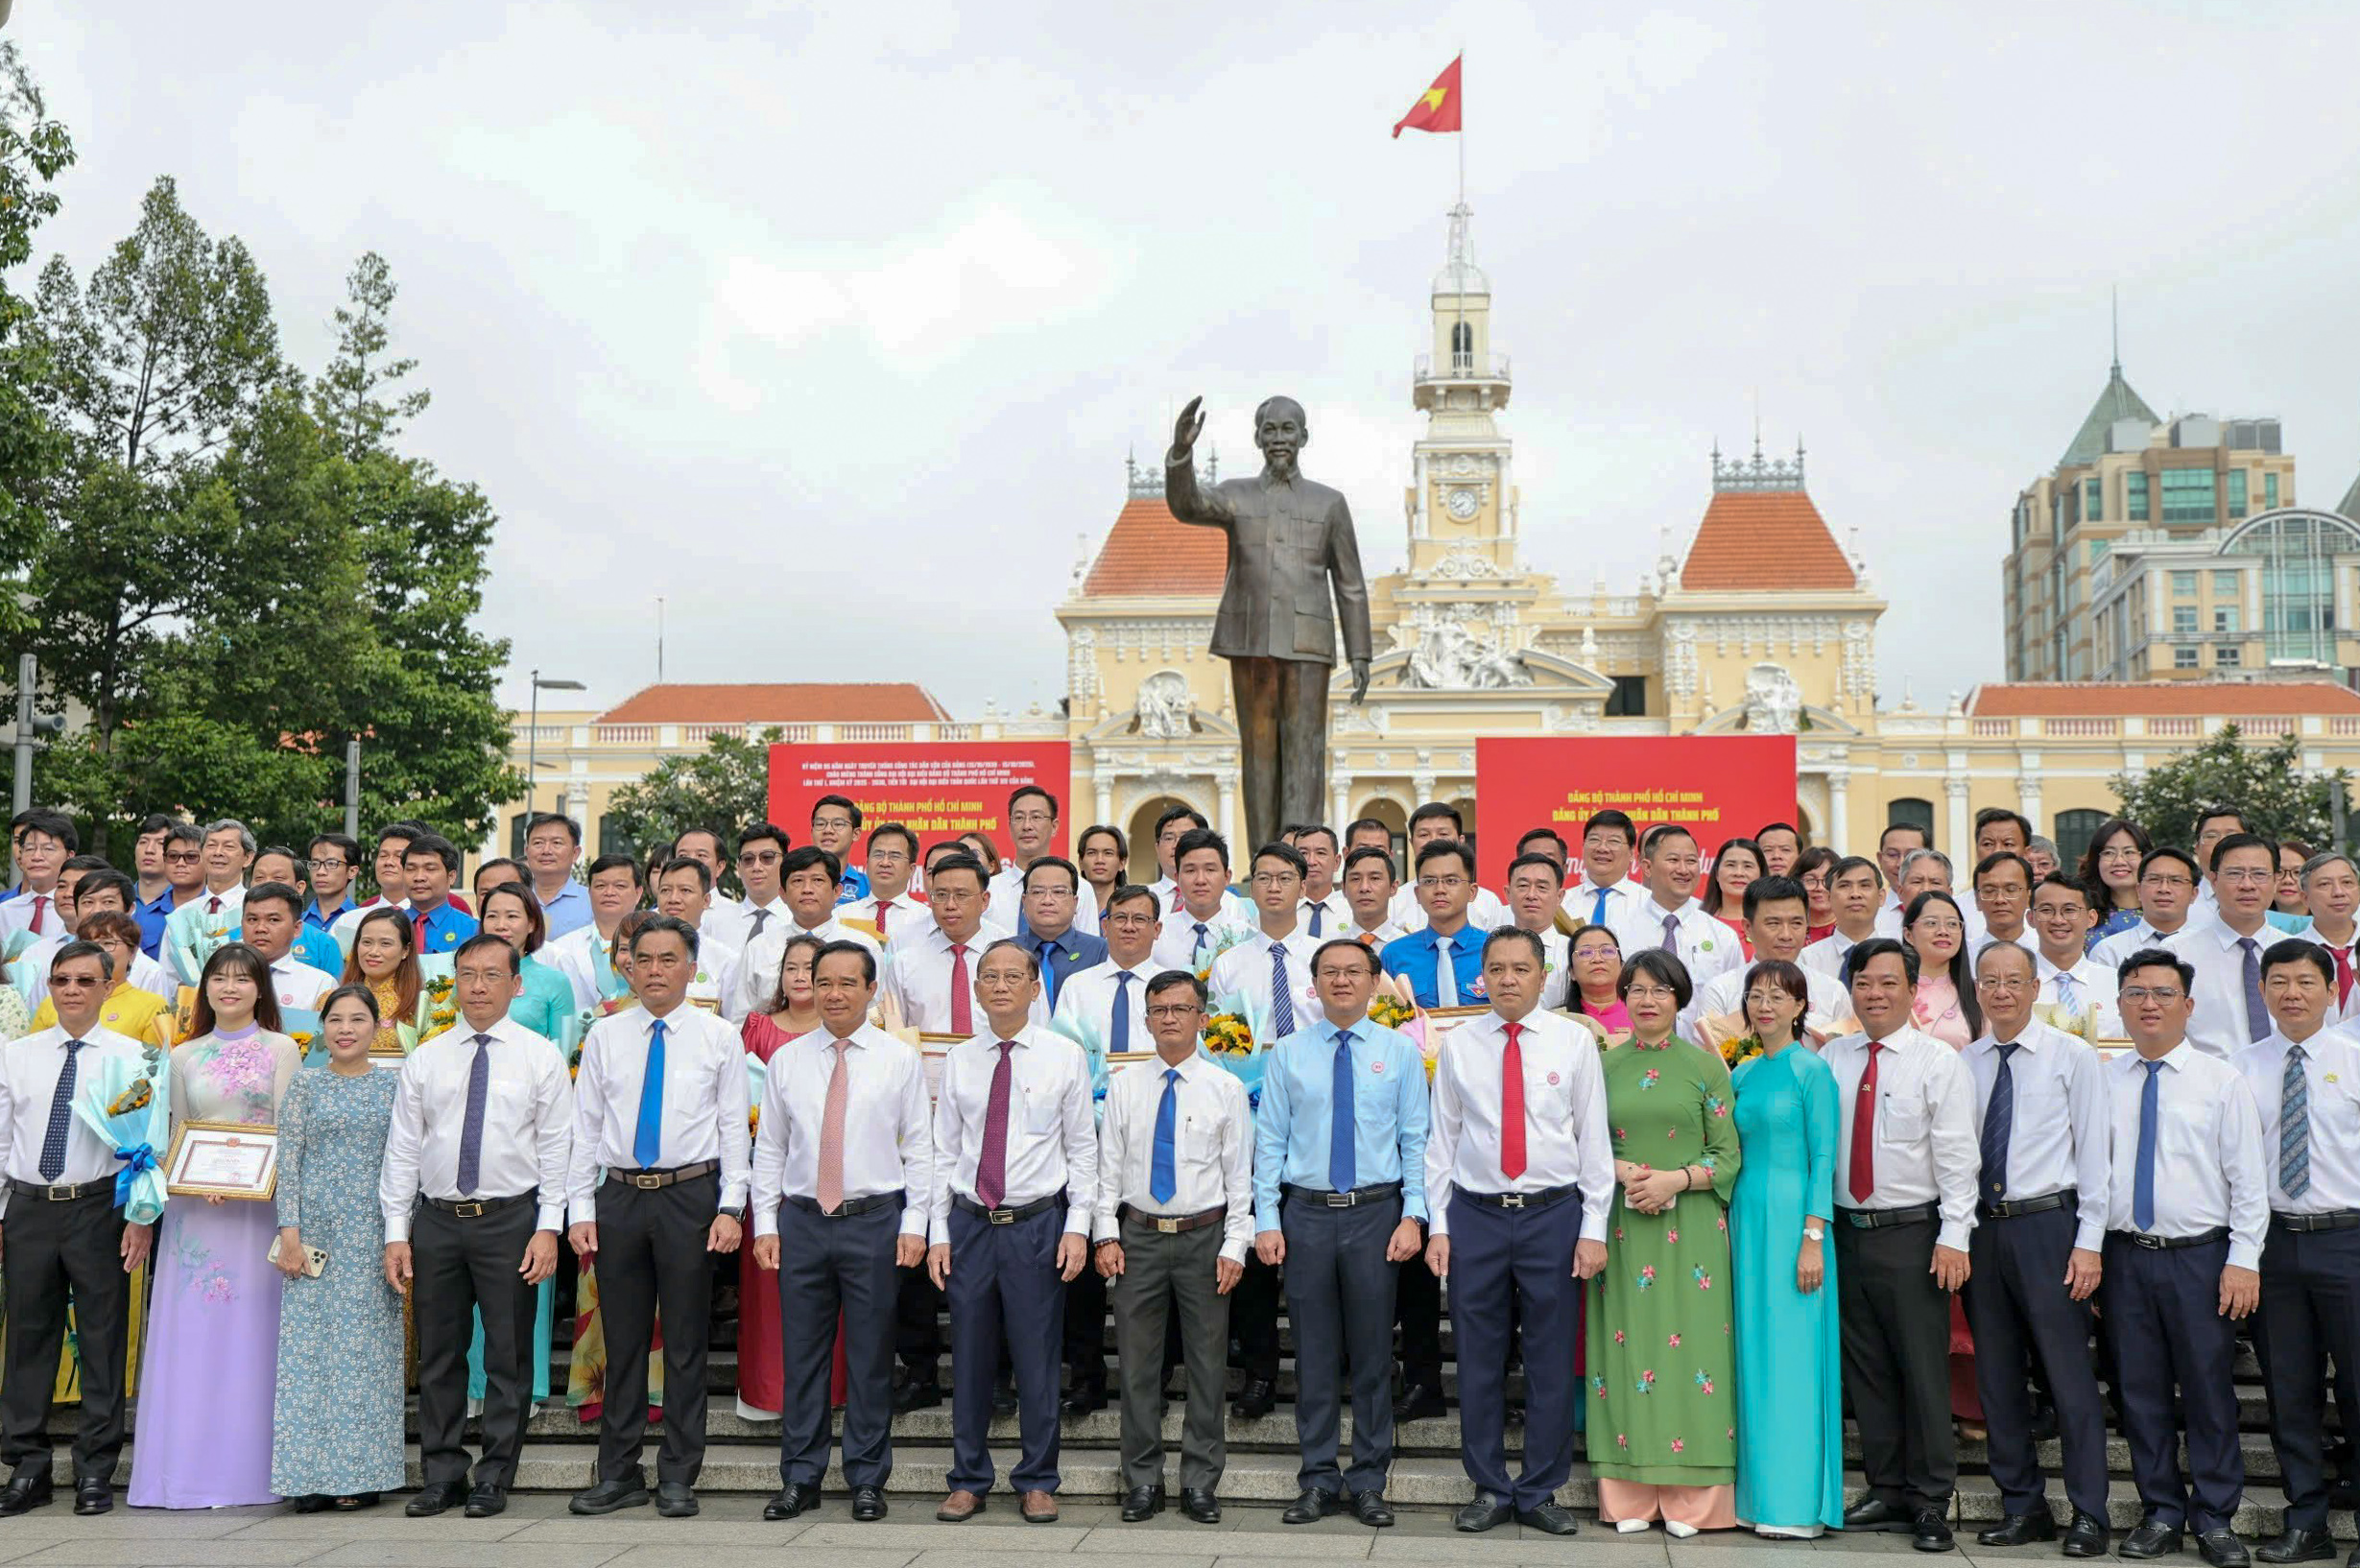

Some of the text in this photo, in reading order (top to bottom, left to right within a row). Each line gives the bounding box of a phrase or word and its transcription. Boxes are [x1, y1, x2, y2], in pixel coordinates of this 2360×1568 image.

[1568, 788, 1703, 805] ĐẢNG BỘ THÀNH PHỐ HỒ CHÍ MINH
[875, 799, 886, 815] BỘ
[889, 799, 915, 813] THÀNH
[917, 797, 932, 812] PHỐ
[934, 796, 945, 812] HỒ
[946, 798, 959, 811] CHÍ
[961, 801, 982, 812] MINH
[1553, 807, 1575, 821] ĐẢNG
[1651, 807, 1668, 821] DÂN
[1671, 807, 1699, 821] THÀNH
[1701, 807, 1720, 821] PHỐ
[906, 817, 928, 830] NHÂN
[931, 817, 947, 830] DÂN
[950, 817, 977, 830] THÀNH
[980, 817, 997, 831] PHỐ
